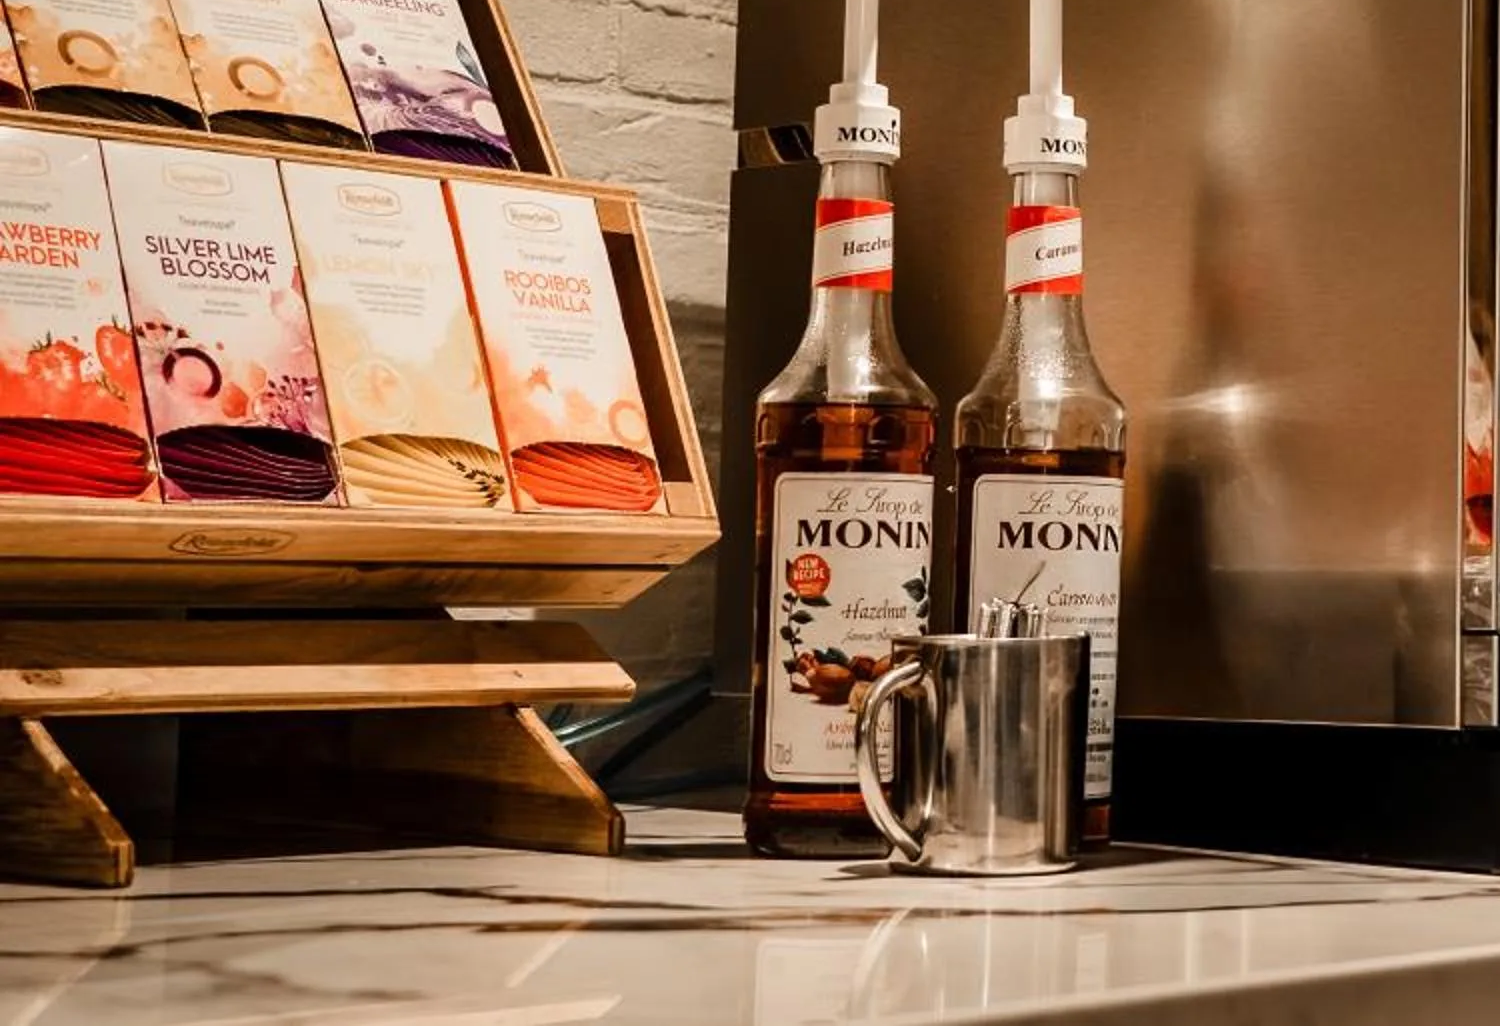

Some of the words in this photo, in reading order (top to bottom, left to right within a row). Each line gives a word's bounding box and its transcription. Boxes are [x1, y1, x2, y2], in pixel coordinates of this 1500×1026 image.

[837, 119, 899, 147] MONI
[144, 234, 222, 260] SILVER
[226, 240, 278, 266] LIME
[160, 256, 272, 286] BLOSSOM
[511, 289, 592, 314] VANILLA
[816, 487, 851, 514] Le
[855, 487, 907, 521] Sirop
[1018, 489, 1054, 516] Le
